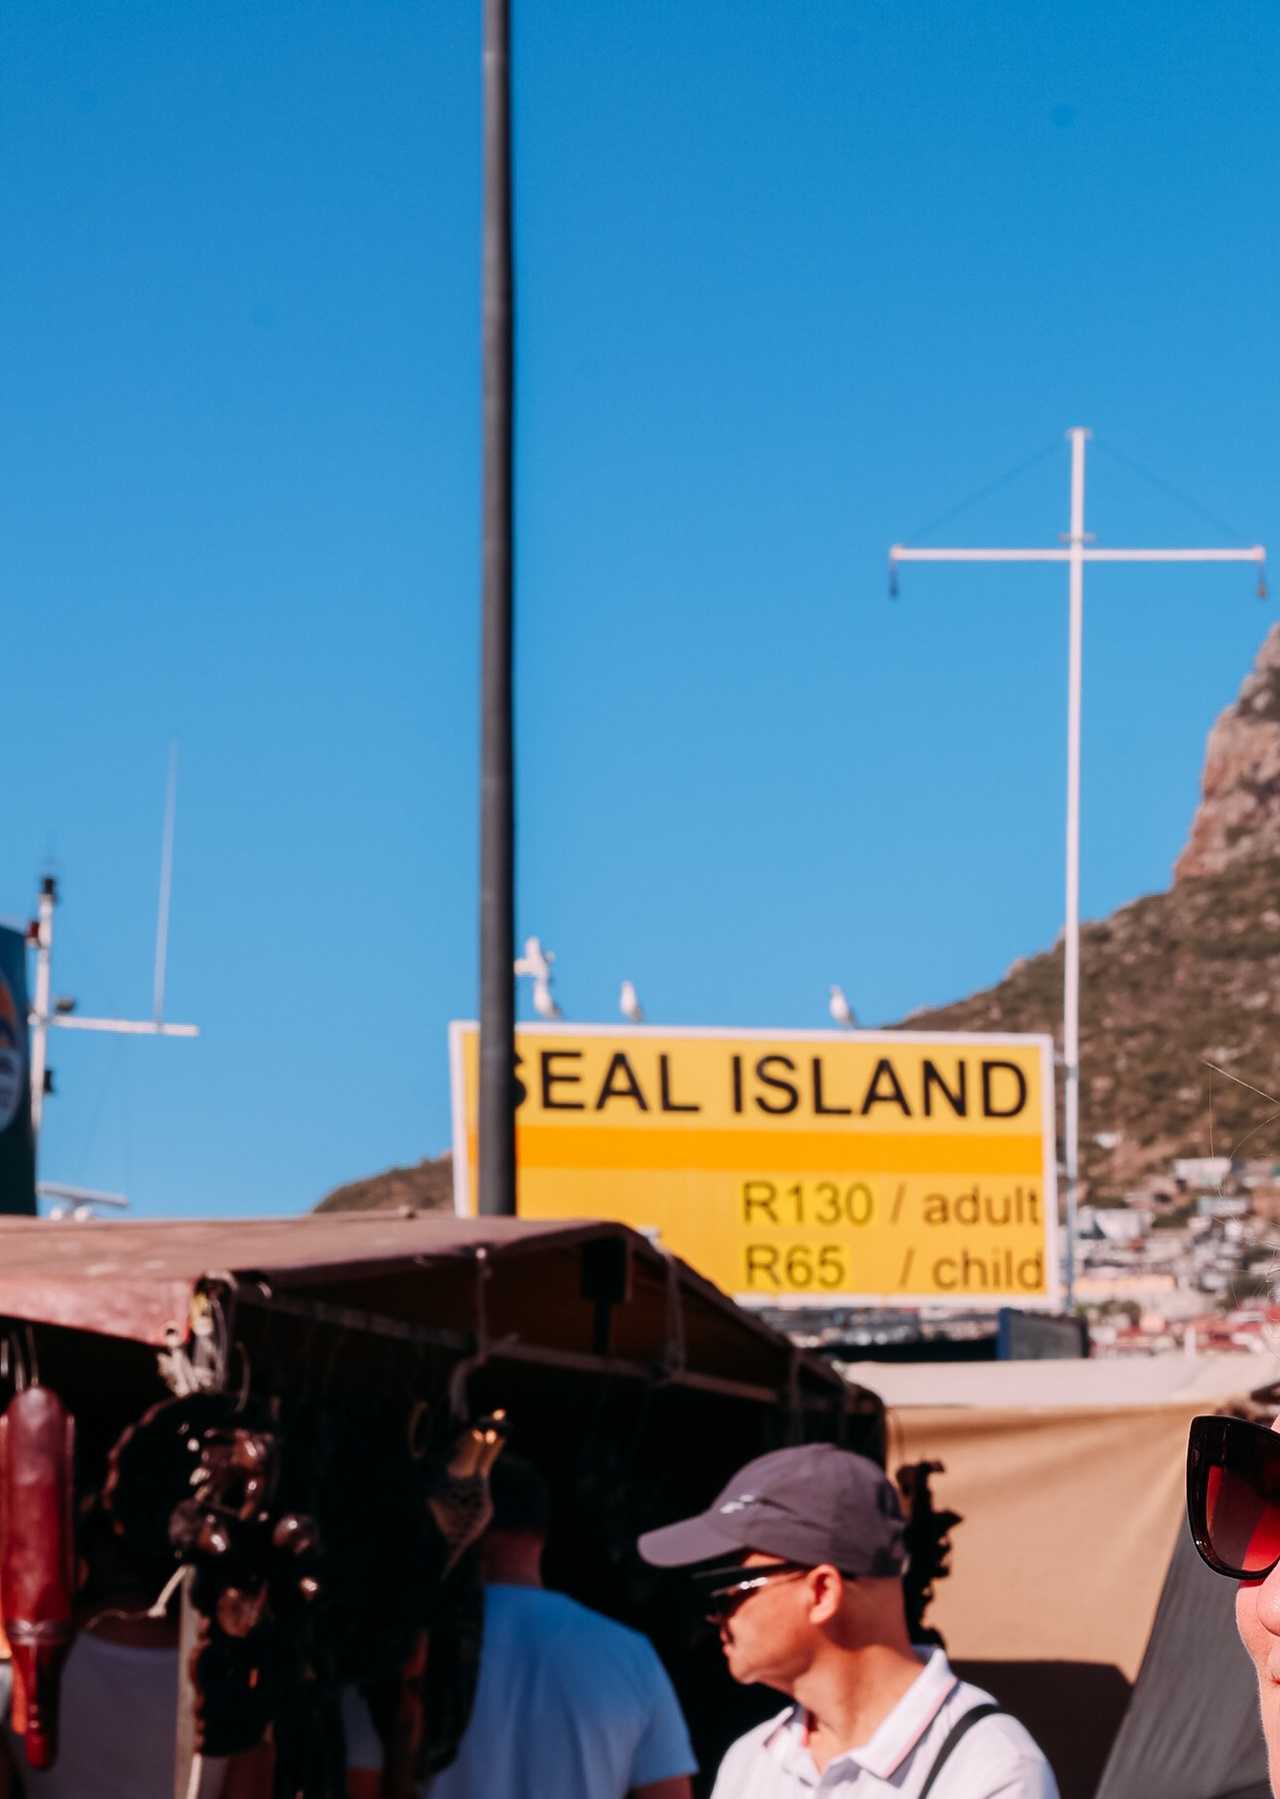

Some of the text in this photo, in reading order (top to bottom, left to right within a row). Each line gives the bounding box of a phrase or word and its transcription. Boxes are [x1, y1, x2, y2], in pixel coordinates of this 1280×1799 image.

[730, 1054, 1029, 1119] ISLAND
[741, 1181, 1042, 1226] R130 / adult
[744, 1245, 1044, 1290] R65 / child
